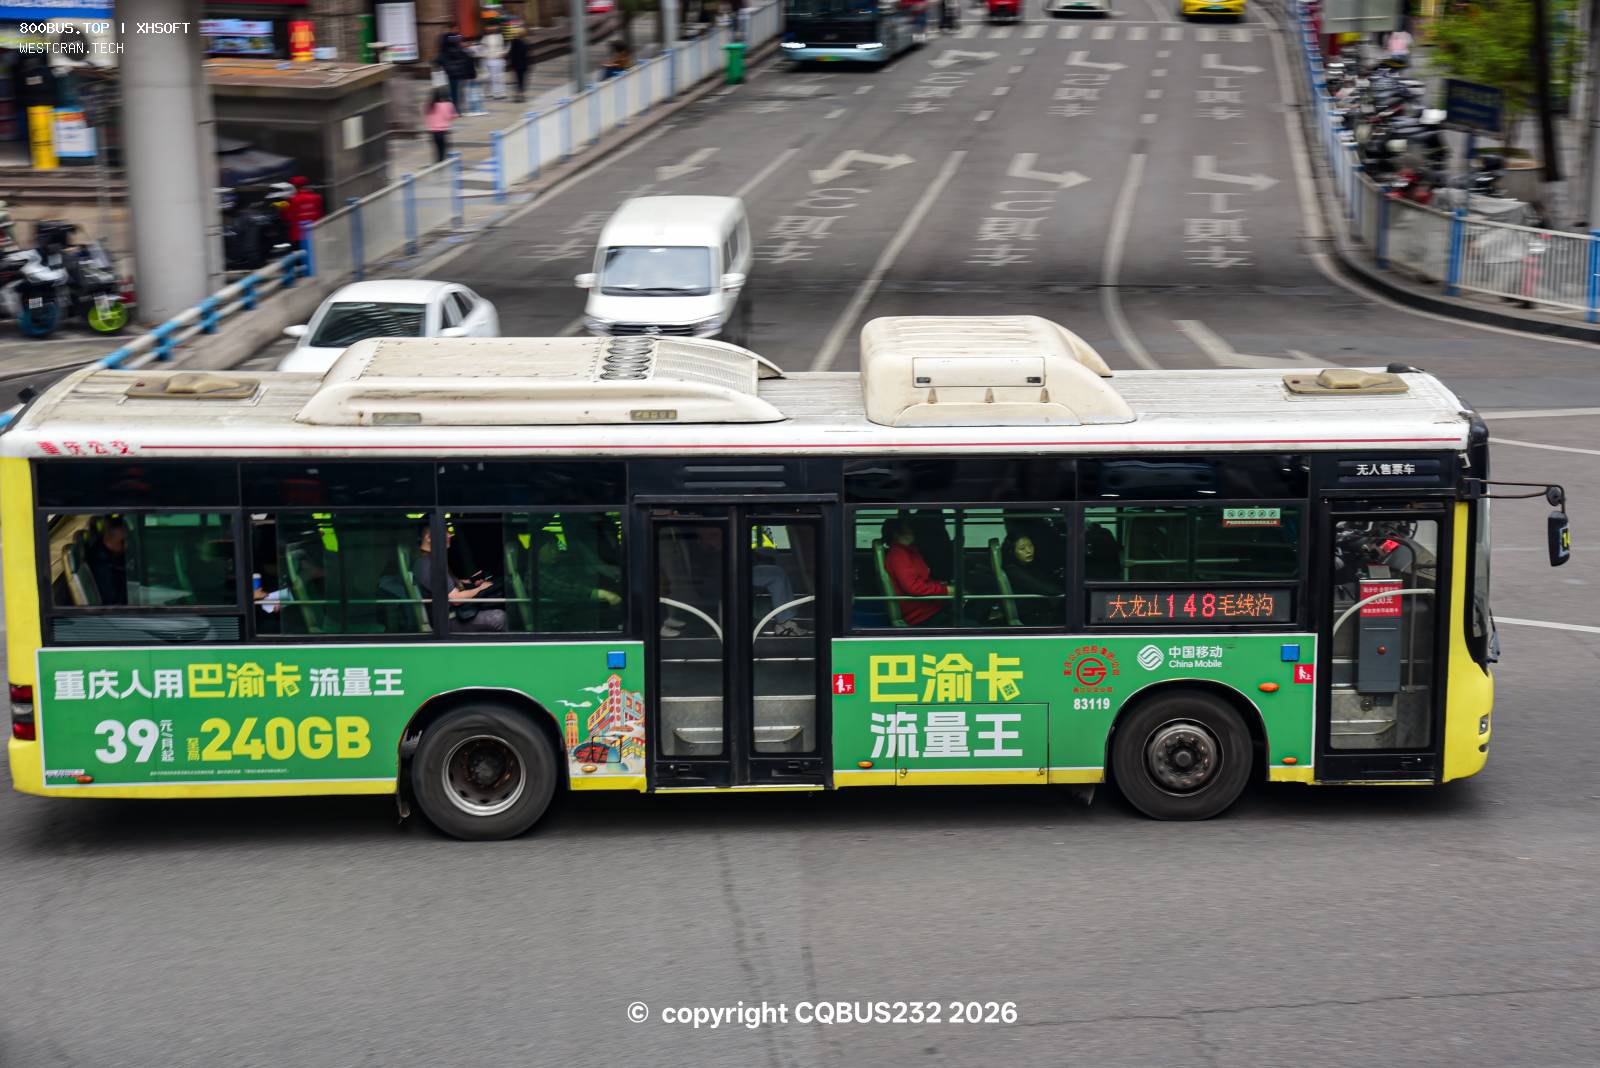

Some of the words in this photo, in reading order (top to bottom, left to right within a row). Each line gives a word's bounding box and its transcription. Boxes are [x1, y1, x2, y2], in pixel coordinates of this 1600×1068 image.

[1356, 463, 1416, 476] 无人售票车
[1166, 593, 1216, 618] 148
[1218, 593, 1273, 617] 毛线沟
[1168, 645, 1223, 659] 中国移动
[1168, 660, 1194, 668] China
[1194, 659, 1223, 668] Mobile
[310, 667, 405, 697] 流量王
[869, 652, 1024, 703] 巴渝卡
[1073, 698, 1111, 710] 83119
[94, 718, 160, 764] 39
[200, 715, 372, 762] 240GB
[870, 711, 1024, 759] 流量王
